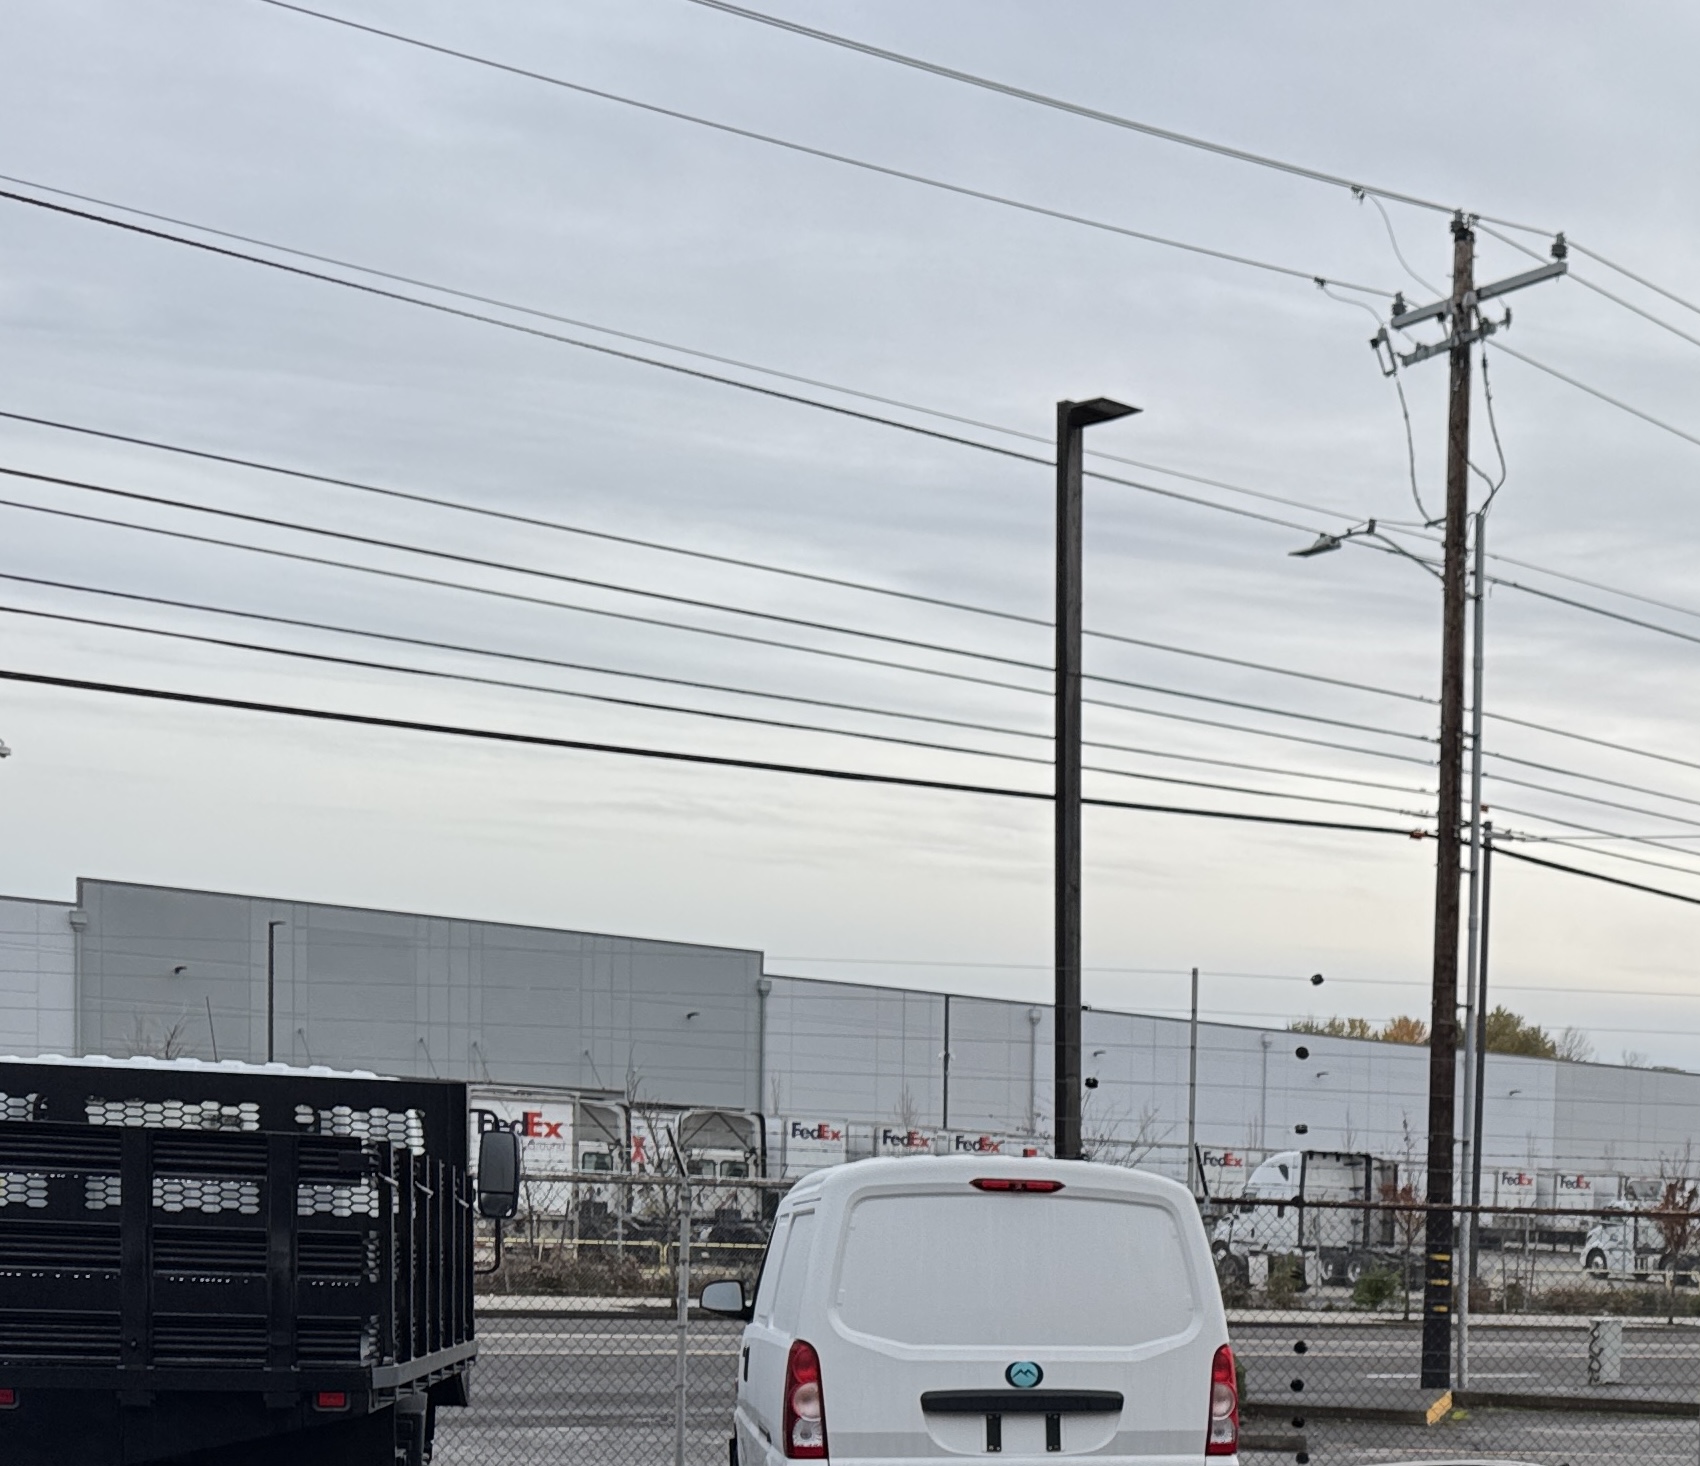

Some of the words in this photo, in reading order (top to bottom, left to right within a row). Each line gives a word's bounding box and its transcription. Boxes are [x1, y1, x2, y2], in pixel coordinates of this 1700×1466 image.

[478, 1111, 563, 1138] FedEx
[792, 1121, 841, 1141] FedEx
[883, 1129, 928, 1147] FedEx
[955, 1135, 999, 1153] FedEx
[1203, 1151, 1242, 1168] FedEx
[1502, 1172, 1533, 1187] FedEx
[1560, 1175, 1590, 1189] FedEx
